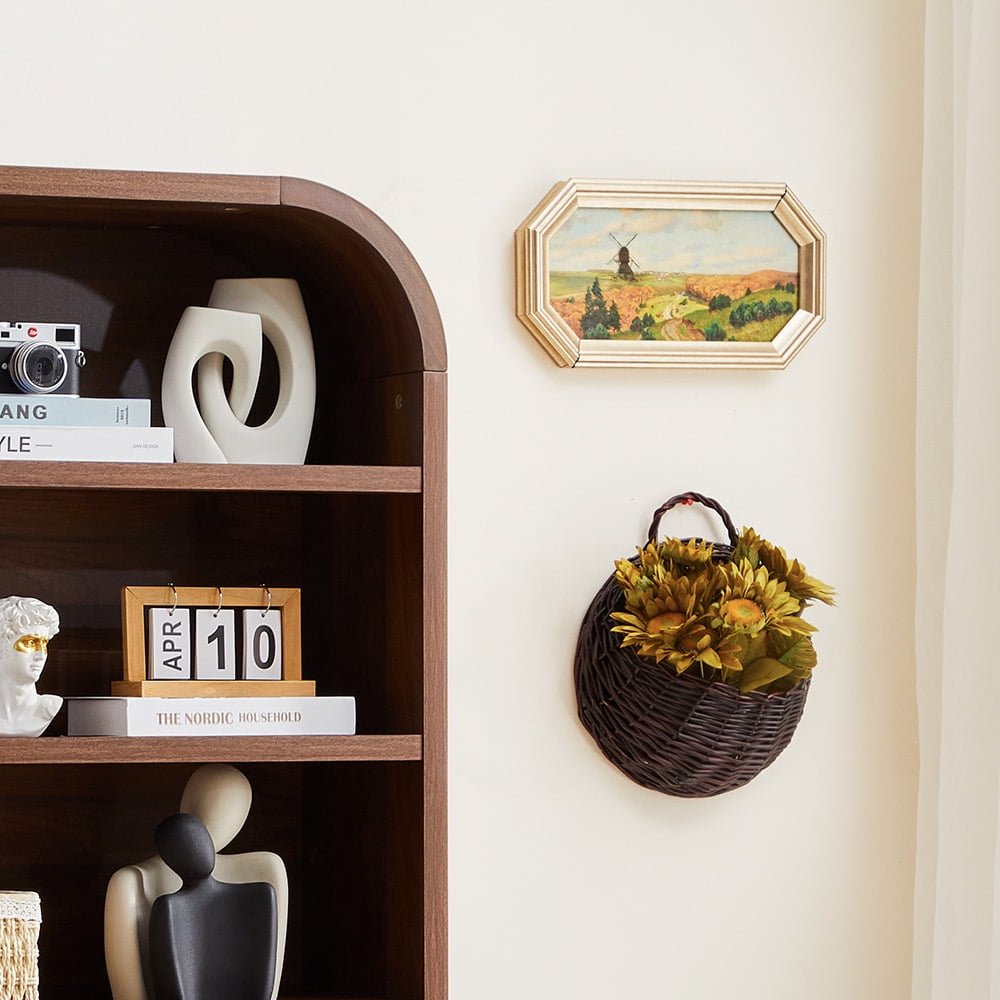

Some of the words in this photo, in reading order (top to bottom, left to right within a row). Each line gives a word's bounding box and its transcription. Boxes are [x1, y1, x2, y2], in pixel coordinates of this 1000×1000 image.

[163, 621, 182, 671] APR
[156, 712, 181, 725] THE
[185, 712, 233, 725] NORDIC
[239, 711, 302, 723] HOUSEHOLD
